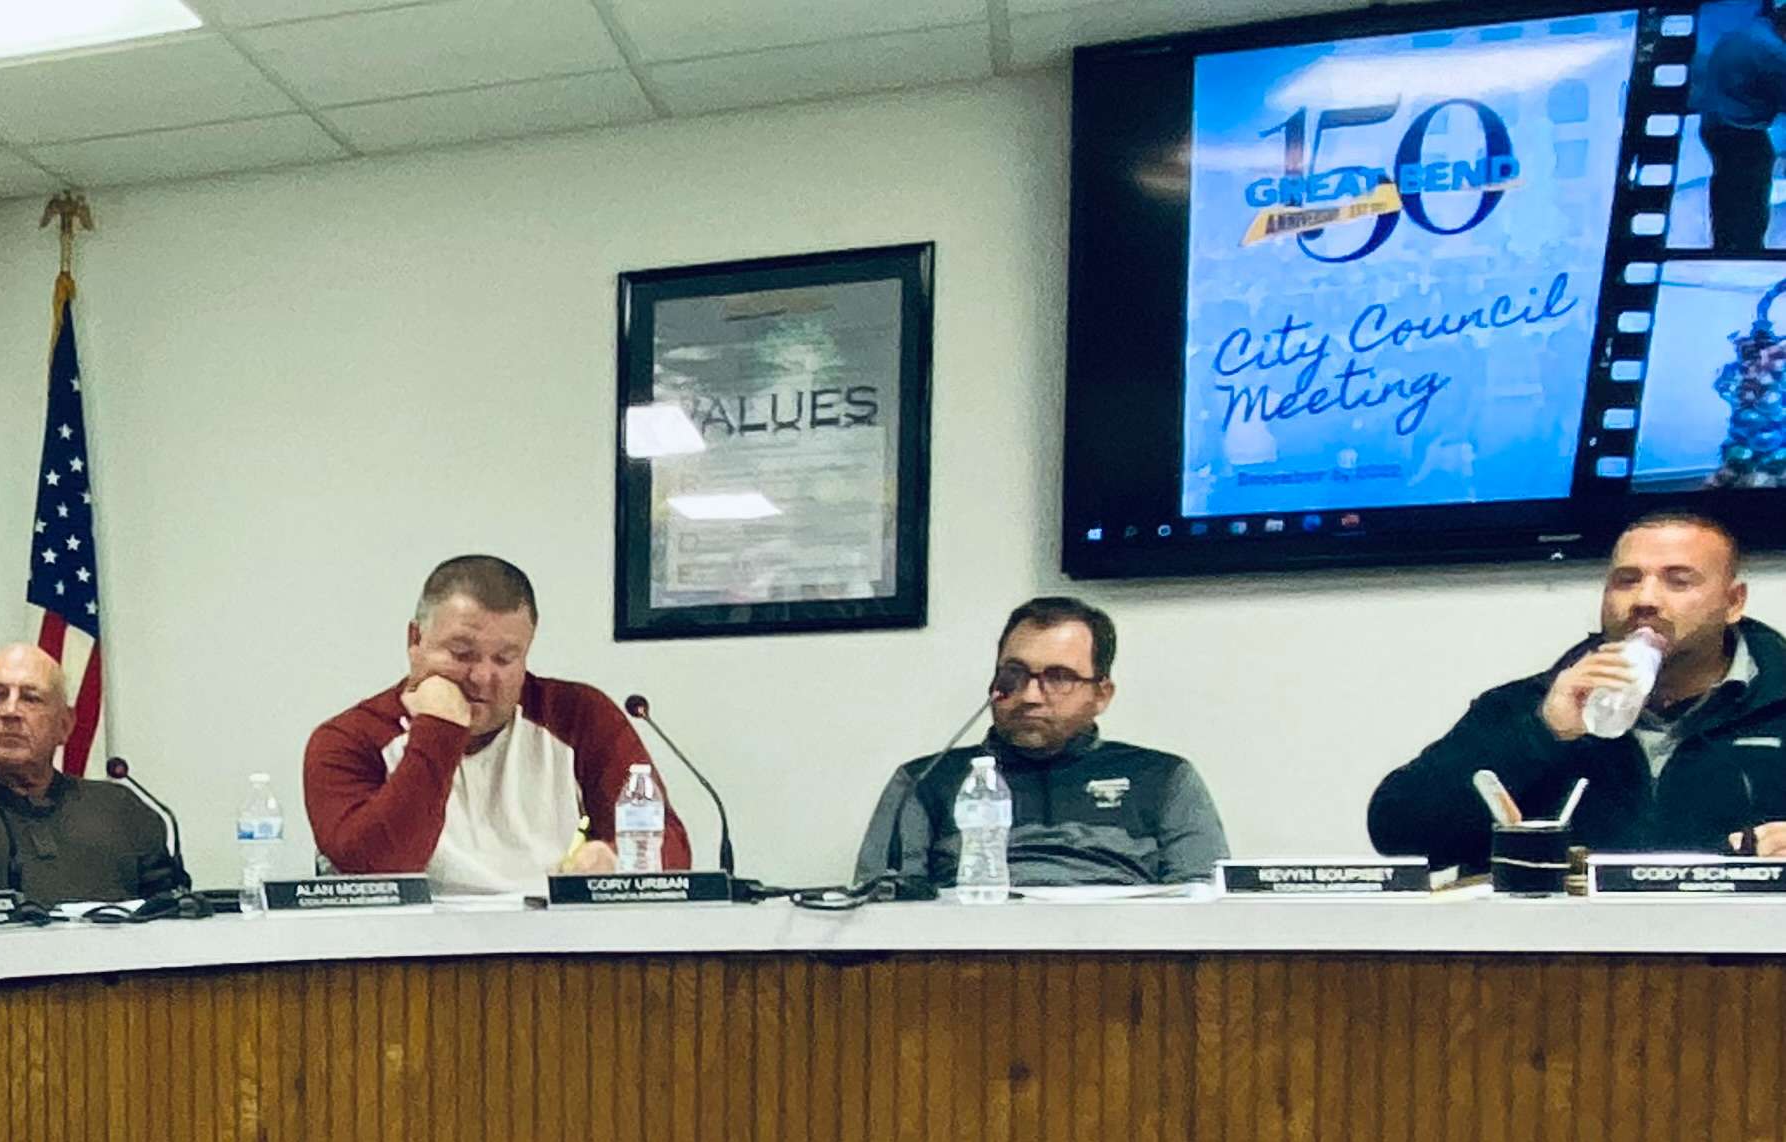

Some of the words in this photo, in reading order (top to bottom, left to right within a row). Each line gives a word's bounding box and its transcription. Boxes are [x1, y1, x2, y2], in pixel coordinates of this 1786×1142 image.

[1245, 166, 1390, 207] GREAT
[1399, 155, 1520, 193] BEND
[1259, 95, 1513, 263] 150
[1214, 313, 1330, 392] City
[1350, 272, 1578, 353] Council
[1217, 359, 1450, 436] Meeting
[296, 883, 334, 897] ALAN
[587, 878, 632, 891] CORY
[634, 877, 690, 890] URBAN
[1632, 867, 1689, 881] CODY
